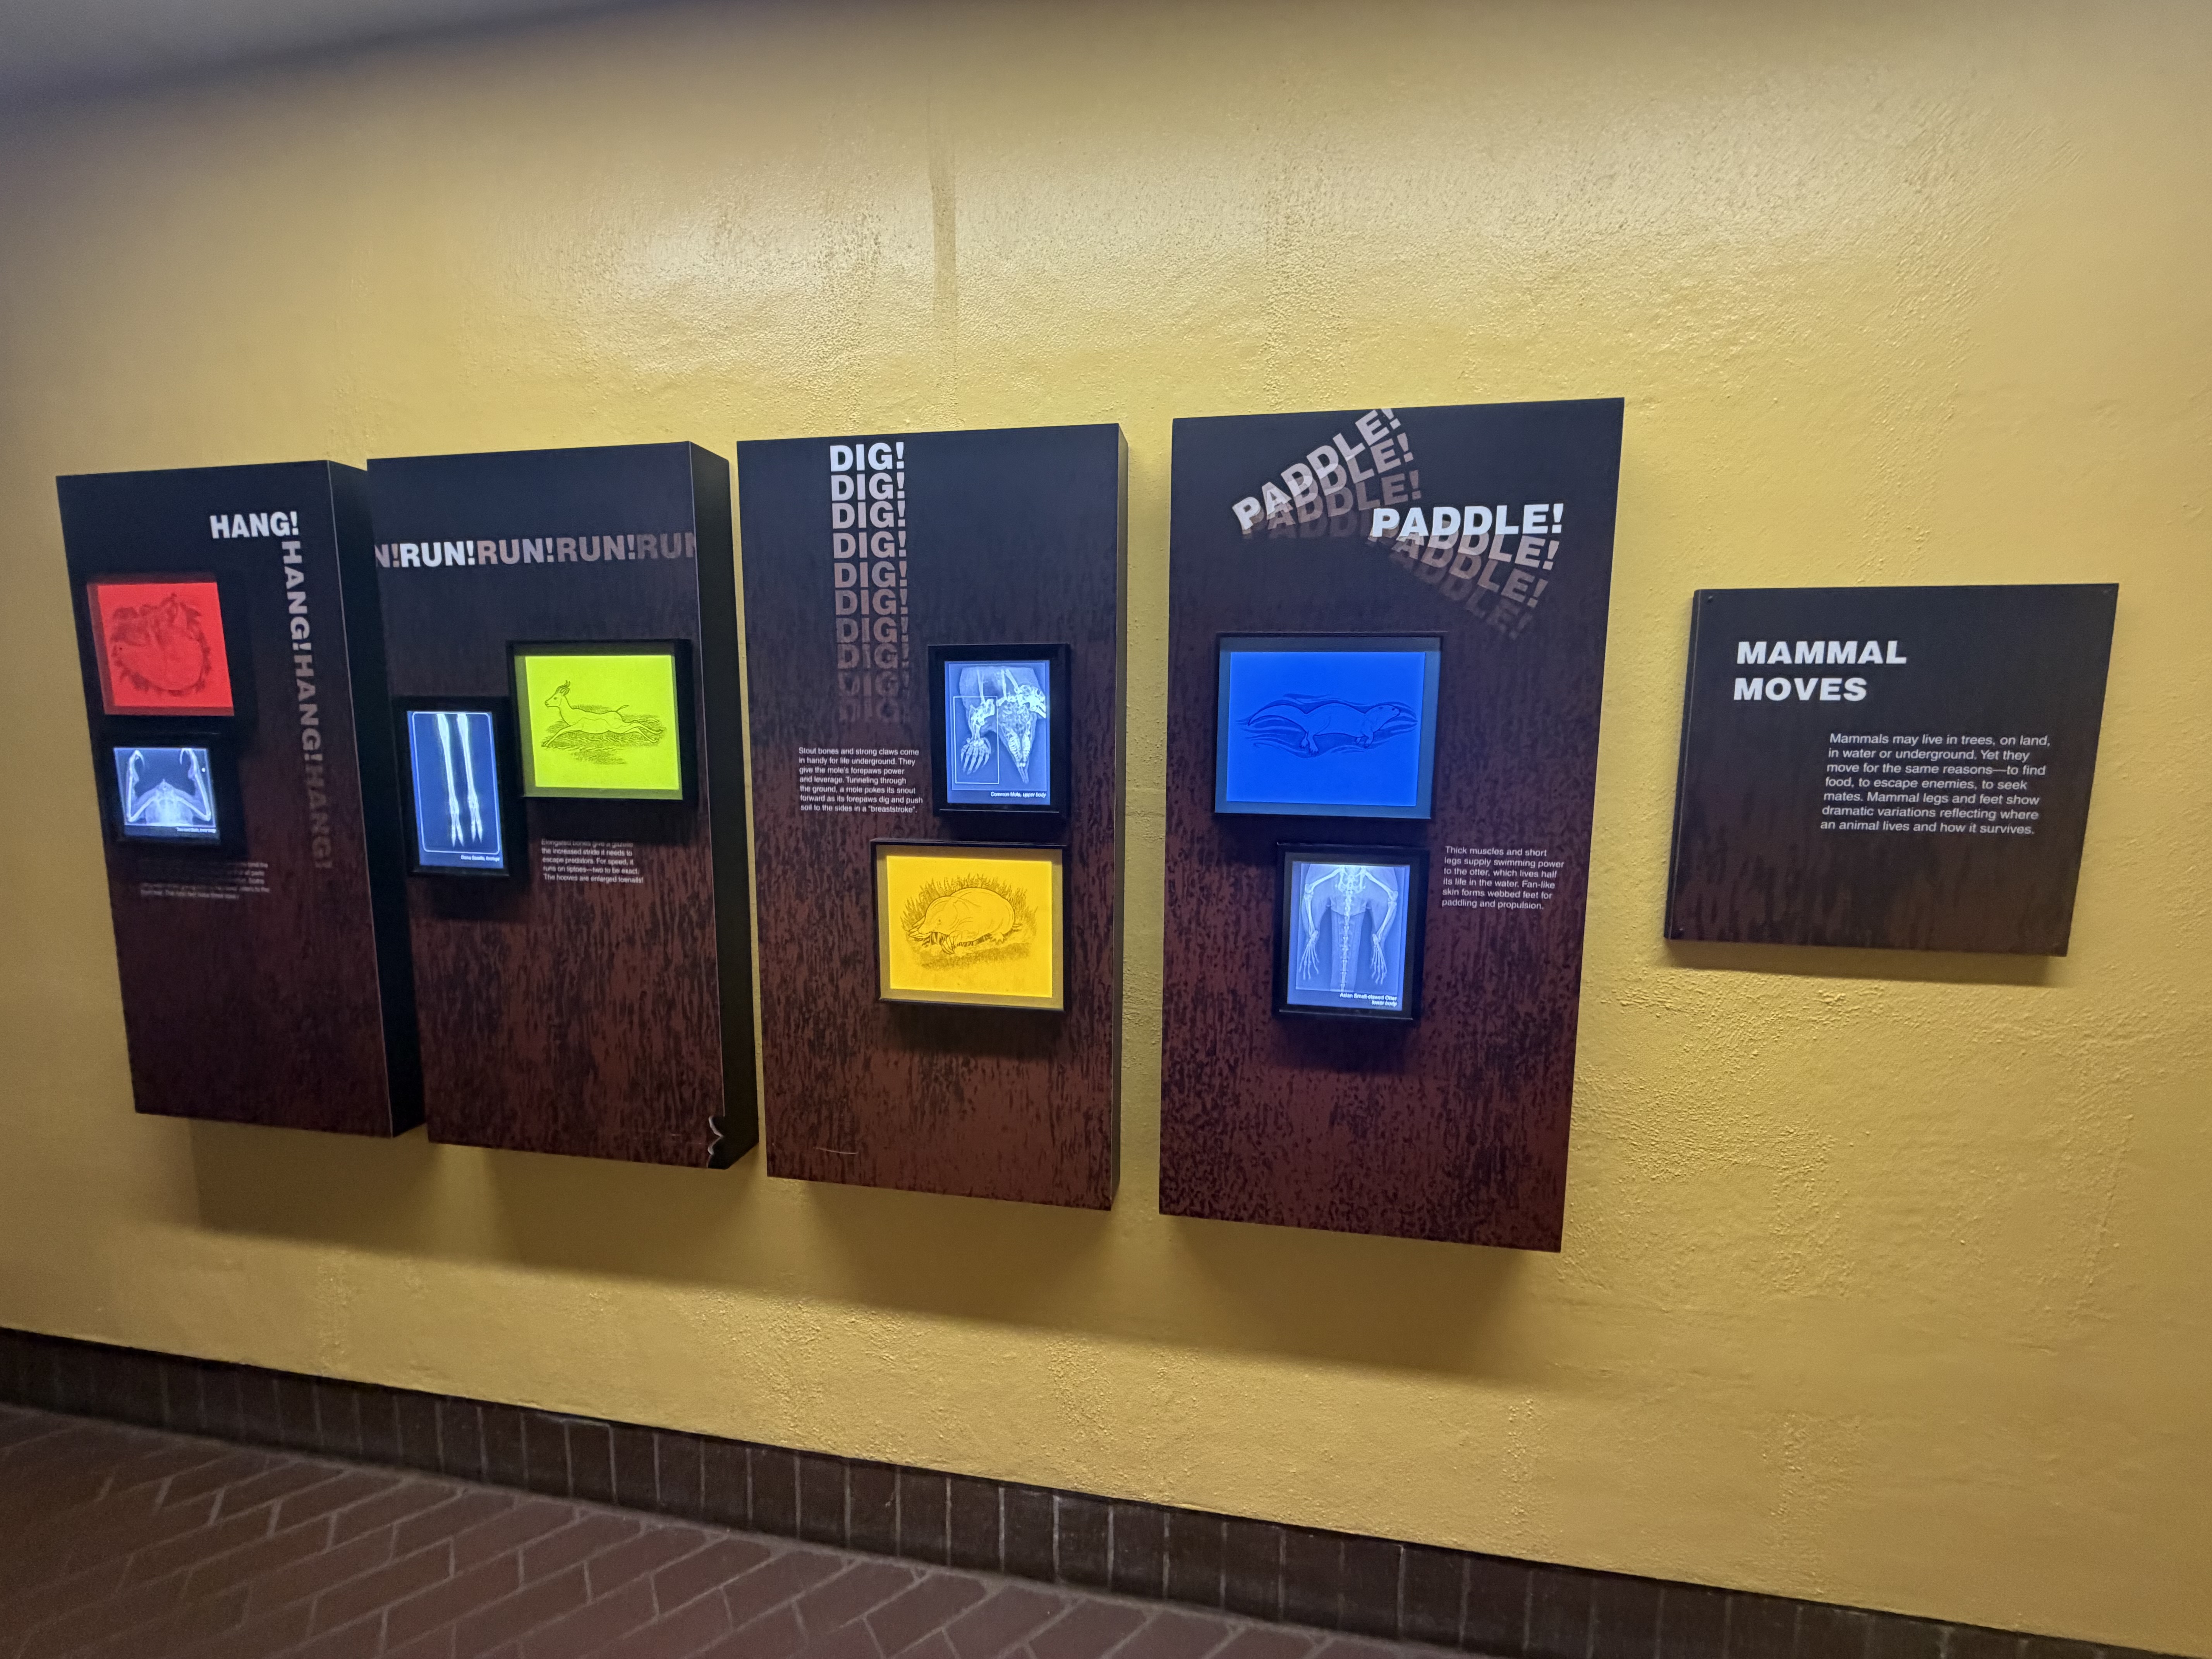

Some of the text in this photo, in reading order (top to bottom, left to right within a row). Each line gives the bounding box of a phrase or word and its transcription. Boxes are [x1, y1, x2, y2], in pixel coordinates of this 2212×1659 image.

[830, 442, 904, 472] DIG!
[1232, 408, 1401, 530] PADDLE!
[831, 472, 905, 501] DIG!
[832, 500, 905, 529] DIG!
[1371, 503, 1564, 537] PADDLE!
[210, 511, 299, 539] HANG!
[833, 531, 906, 558] DIG!
[834, 561, 907, 588] DIG!
[835, 589, 908, 615] DIG!
[836, 617, 908, 643] DIG!
[837, 643, 909, 669] DIG!
[1737, 641, 1906, 664] MAMMAL
[1734, 677, 1867, 701] MOVES
[1830, 733, 2051, 747] Mammals may live in trees, on land,
[898, 758, 915, 766] They
[1828, 748, 2030, 763] in water or underground. Yet they
[1827, 764, 1859, 773] move
[1863, 763, 1880, 773] for
[1882, 763, 1901, 773] the
[1905, 766, 1939, 774] same
[2023, 765, 2046, 776] find
[845, 776, 878, 785] Tunneling
[880, 777, 906, 785] through
[1825, 777, 2028, 790] food, to escape enemies, to seek
[1823, 792, 2039, 805] mates. Mammal legs and feet show
[1822, 805, 2039, 821] dramatic variations reflecting where
[1839, 821, 1879, 830] animal
[1882, 821, 1910, 831] lives
[1913, 821, 1936, 832] and
[1940, 822, 1965, 833] how
[1969, 823, 1977, 833] it
[1980, 823, 2034, 835] survives.
[1444, 857, 1461, 866] legs
[1464, 858, 1491, 867] supply
[1494, 859, 1535, 868] swimming
[1469, 869, 1490, 877] otter,
[1520, 869, 1539, 878] lives
[1462, 888, 1485, 896] forms
[1522, 880, 1555, 889] Fan-like
[1442, 899, 1477, 908] paddling
[1498, 901, 1544, 910] propulsion.
